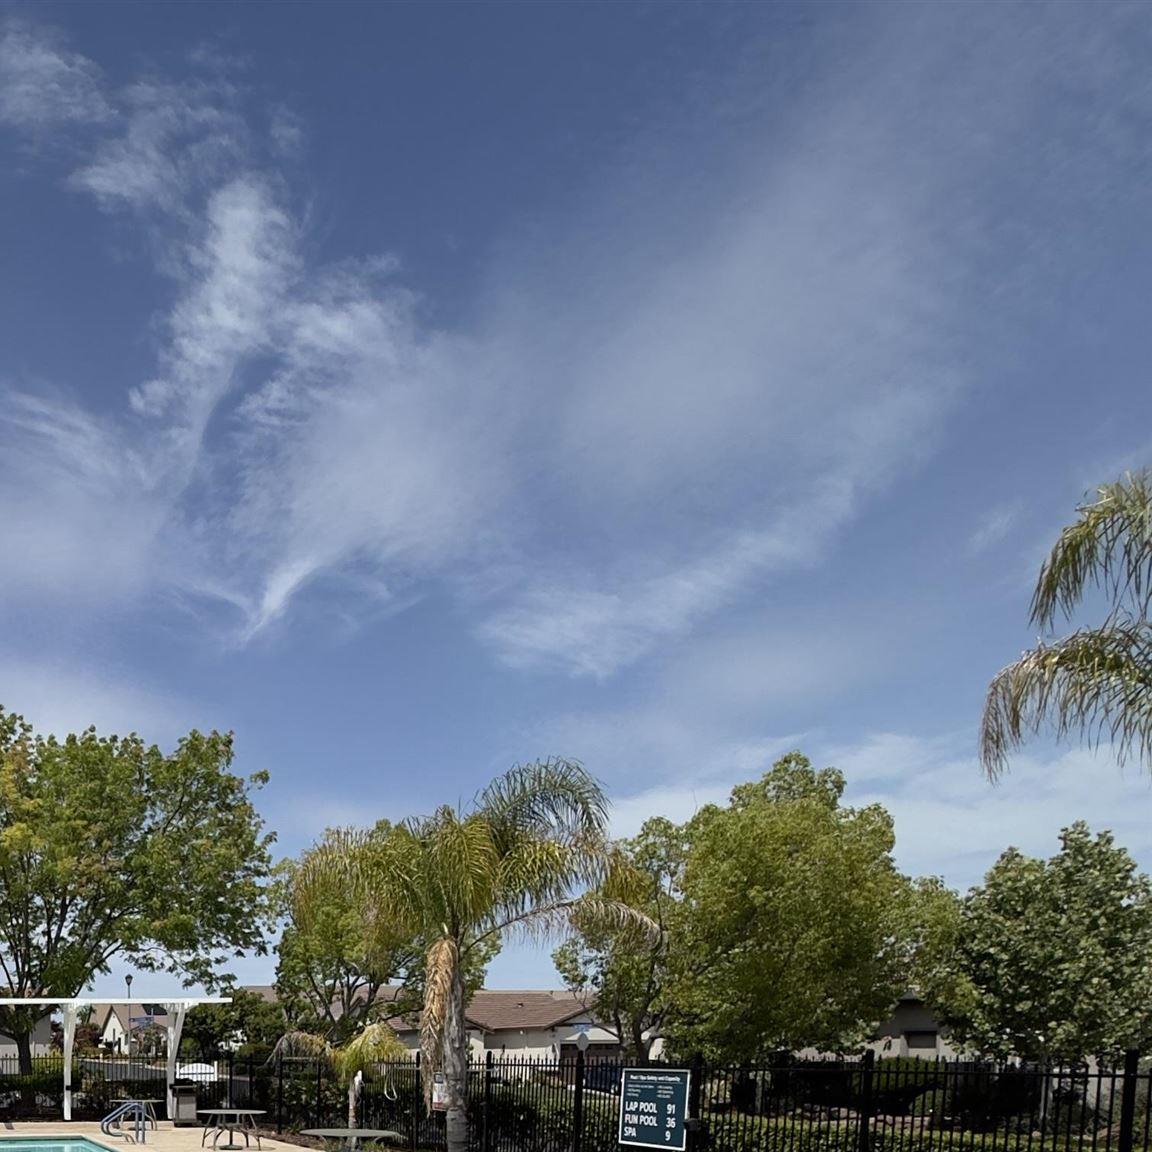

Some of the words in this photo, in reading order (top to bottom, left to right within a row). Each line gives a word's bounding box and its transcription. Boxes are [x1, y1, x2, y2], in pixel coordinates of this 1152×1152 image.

[625, 1101, 639, 1111] LAP
[639, 1102, 658, 1113] POOL
[666, 1103, 676, 1115] 91
[624, 1113, 638, 1125] FUN
[639, 1115, 658, 1127] POOL
[665, 1117, 676, 1128] 36
[623, 1126, 637, 1137] SPA
[664, 1130, 671, 1141] 9
